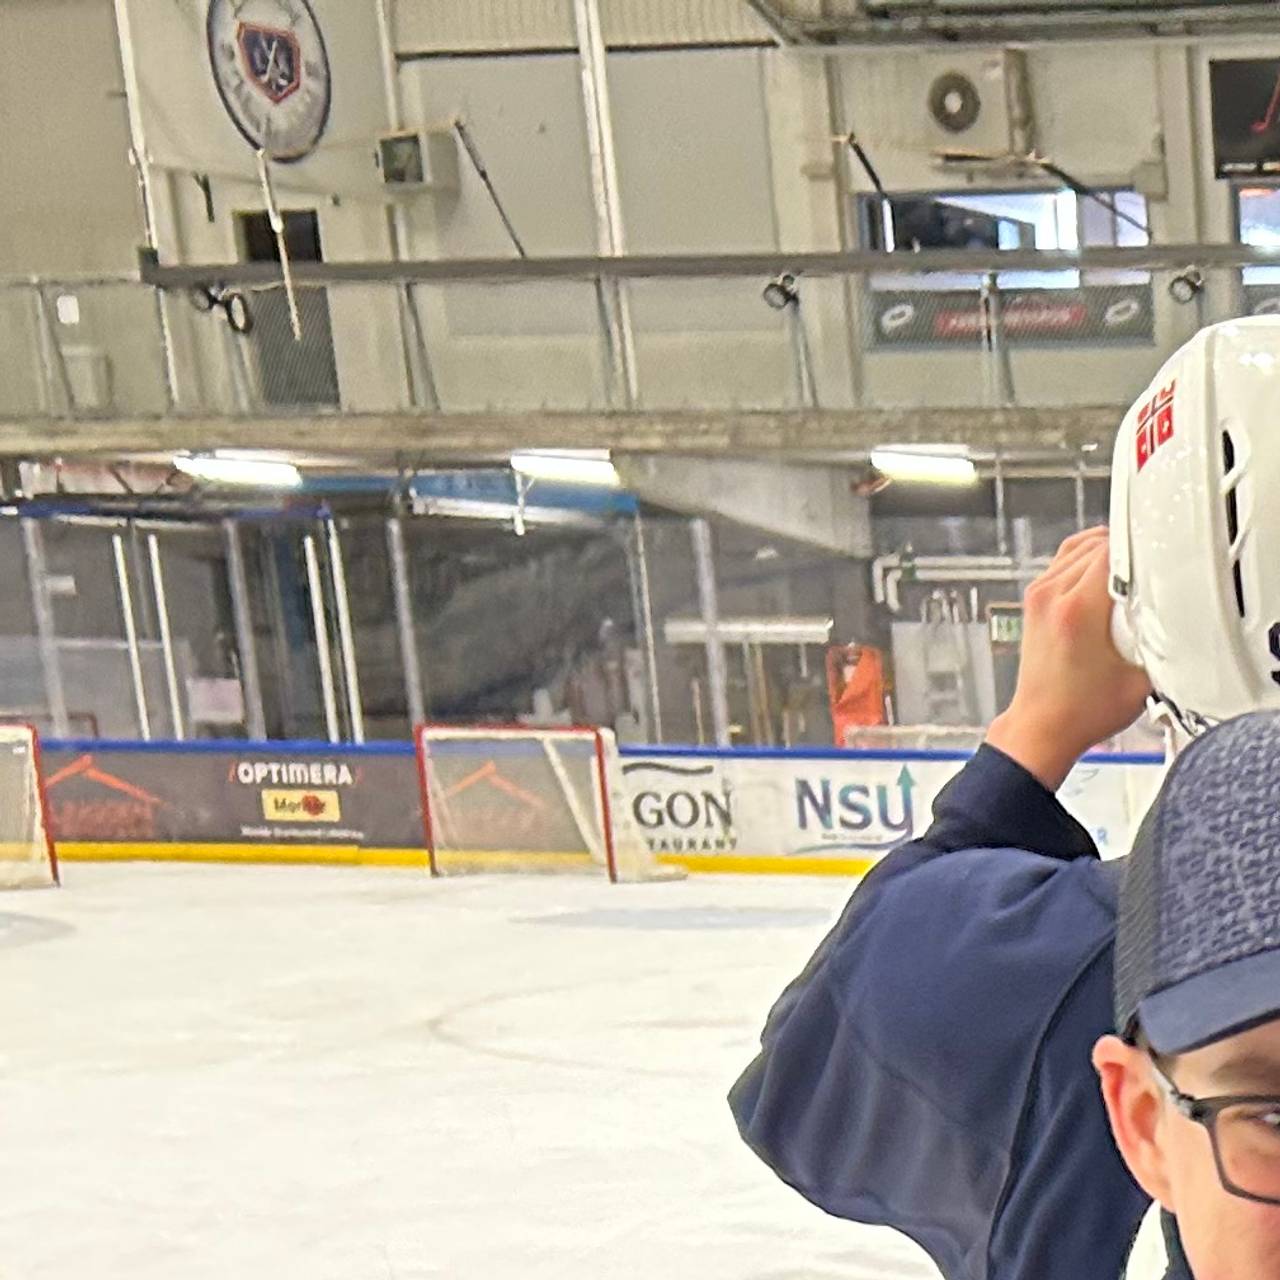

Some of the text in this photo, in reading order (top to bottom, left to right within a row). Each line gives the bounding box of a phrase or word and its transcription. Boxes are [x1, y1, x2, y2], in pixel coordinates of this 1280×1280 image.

[237, 762, 353, 785] OPTIMERA
[632, 790, 733, 829] GON
[796, 766, 915, 831] NSU
